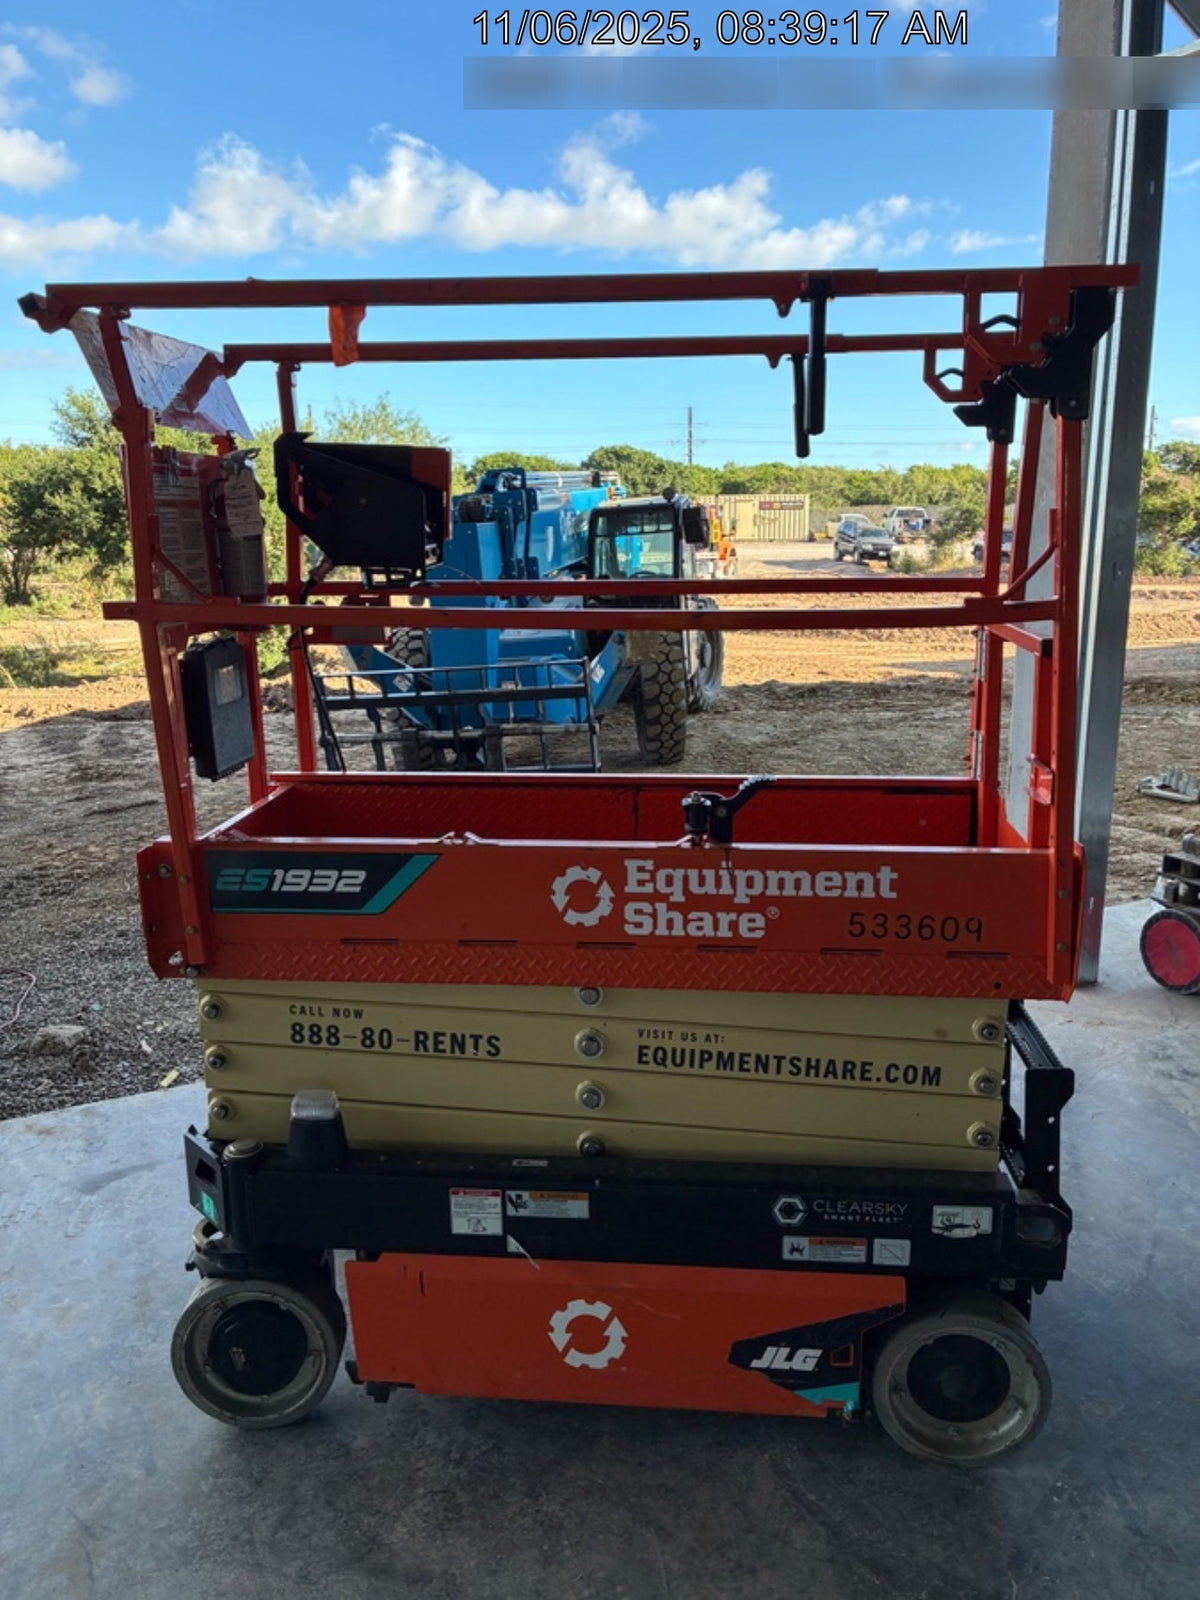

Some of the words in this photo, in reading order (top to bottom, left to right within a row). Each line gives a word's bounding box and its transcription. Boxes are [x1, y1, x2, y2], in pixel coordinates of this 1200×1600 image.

[215, 868, 367, 893] ES1932
[624, 858, 899, 904] Equipment
[847, 912, 983, 943] 533609
[289, 1004, 325, 1018] CALL
[332, 1007, 365, 1020] NOW
[290, 1021, 502, 1058] 888-80-RENTS
[637, 1028, 675, 1042] VISIT
[681, 1031, 698, 1043] US
[704, 1033, 726, 1044] AT:
[636, 1044, 942, 1087] EQUIPMENTSHARE.COM
[812, 1199, 908, 1217] CLEARSKY
[750, 1345, 824, 1372] JLG
